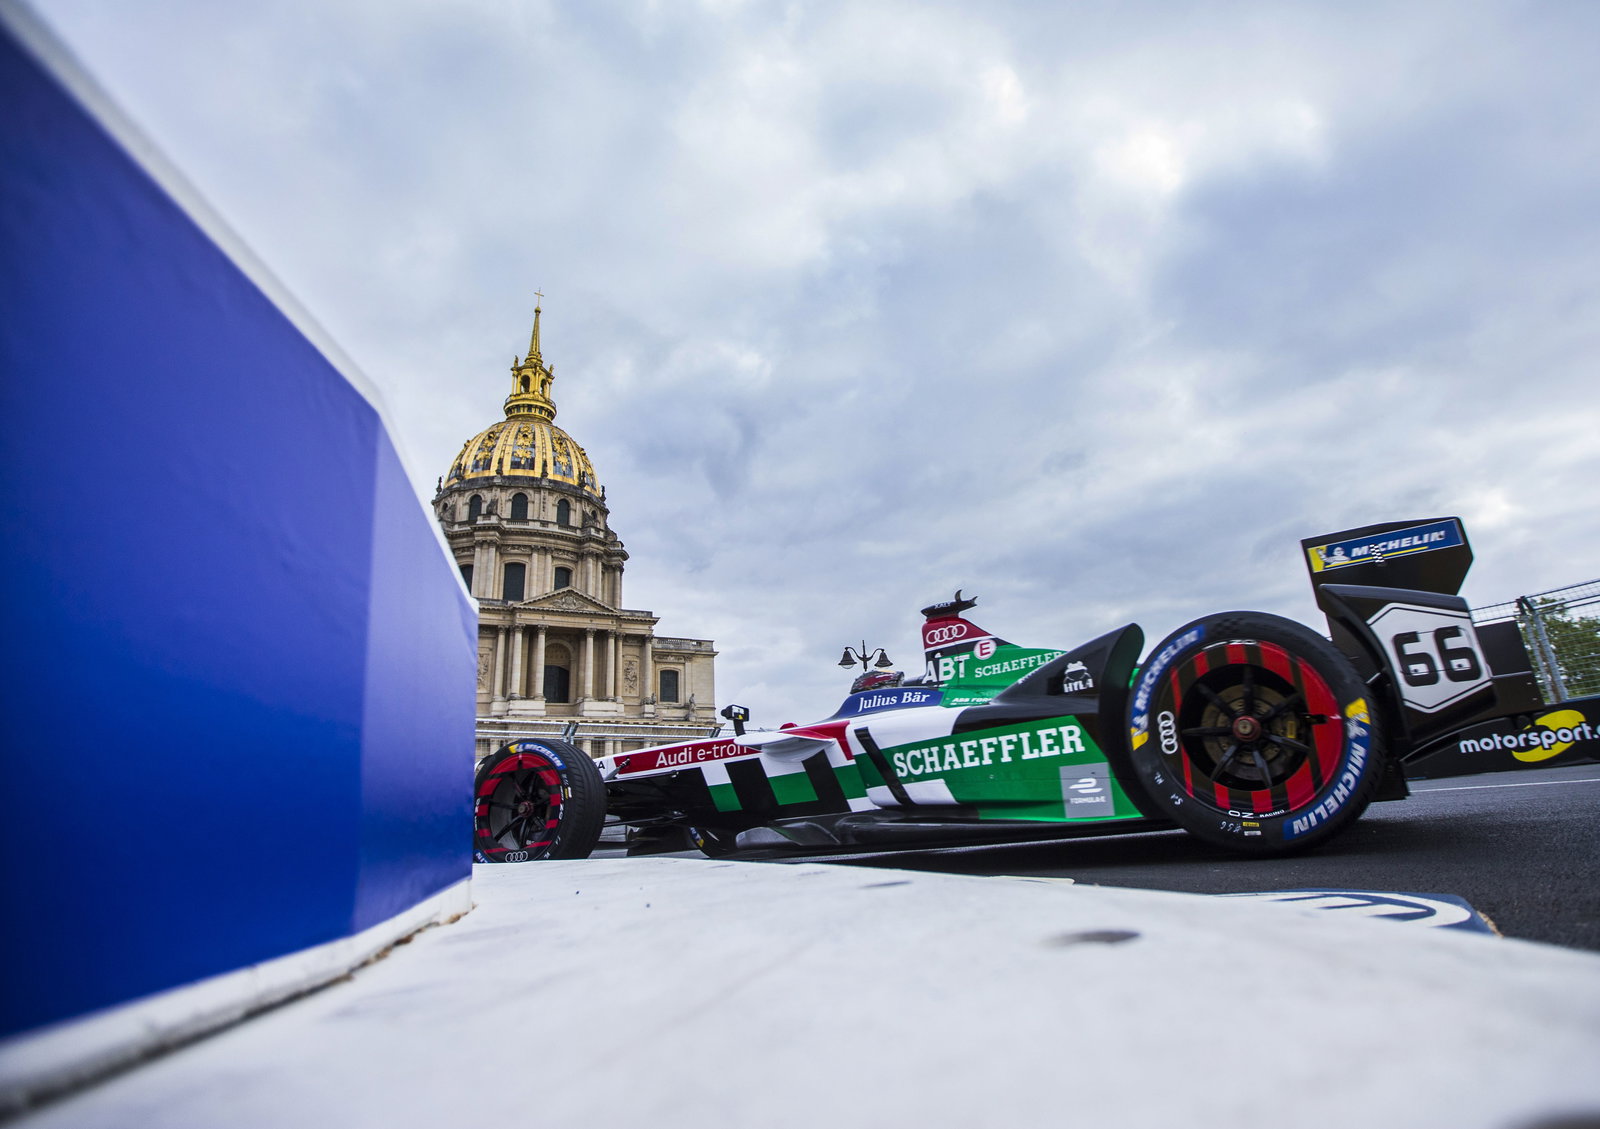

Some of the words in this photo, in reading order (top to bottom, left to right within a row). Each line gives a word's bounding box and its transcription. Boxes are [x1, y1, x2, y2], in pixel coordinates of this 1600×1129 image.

[979, 642, 991, 656] E
[1392, 625, 1482, 687] 66
[921, 654, 970, 684] ABT
[1135, 630, 1198, 711] MICHELIN
[1063, 678, 1094, 693] HYLA
[857, 695, 897, 713] Julius
[901, 691, 931, 704] Bär
[893, 725, 1085, 777] SCHAEFFLER
[1459, 722, 1600, 753] motorsport.
[524, 743, 563, 768] MICHELIN
[655, 747, 692, 767] Audi
[1293, 741, 1366, 835] MICHELIN
[1229, 810, 1254, 819] OZ
[1259, 809, 1285, 818] RACING
